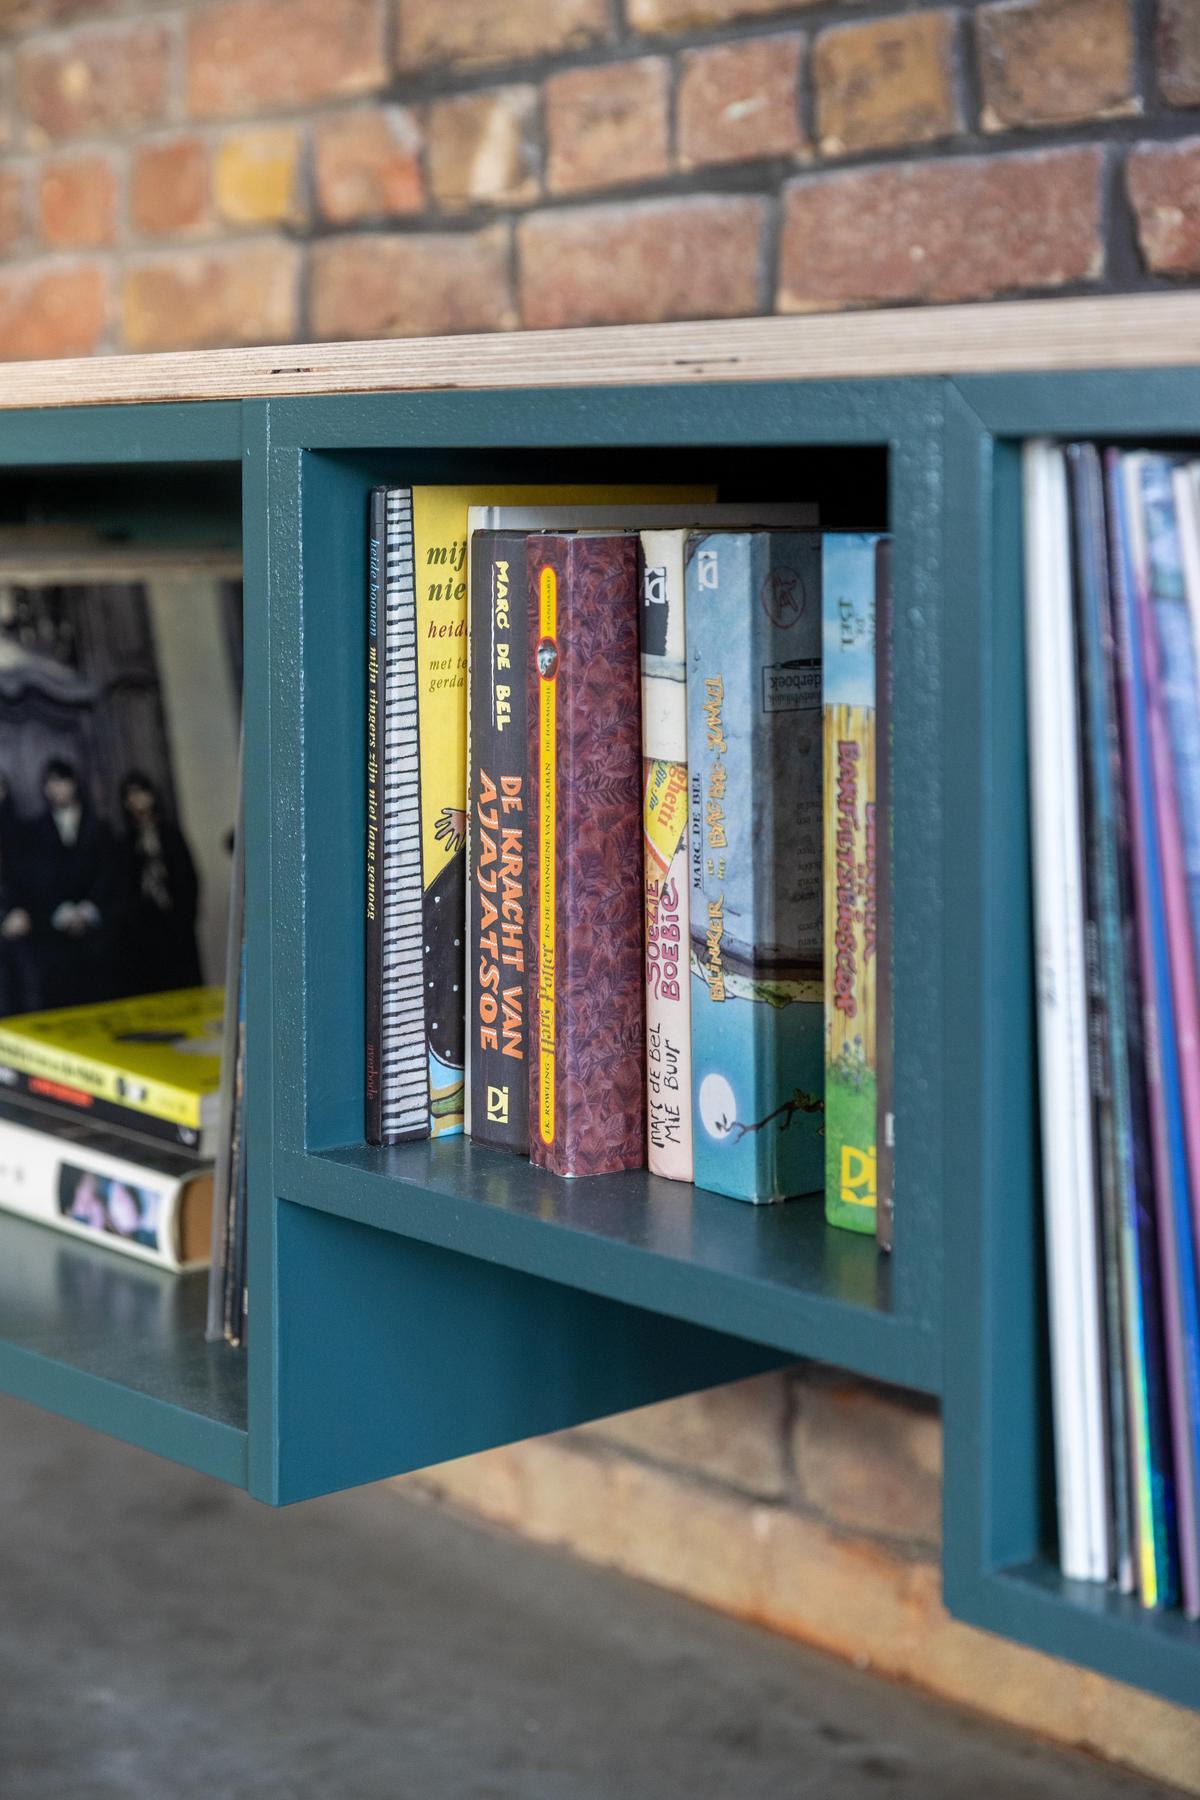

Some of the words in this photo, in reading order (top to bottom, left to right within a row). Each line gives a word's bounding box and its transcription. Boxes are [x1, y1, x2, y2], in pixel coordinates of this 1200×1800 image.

[369, 539, 381, 579] heide
[426, 540, 468, 572] mij
[428, 577, 467, 601] nie
[494, 560, 511, 630] MARC
[369, 583, 380, 637] boonen
[427, 620, 468, 638] heid
[368, 646, 379, 684] mijn
[429, 657, 451, 670] met
[456, 656, 468, 669] te
[496, 643, 511, 672] DE
[428, 676, 464, 693] gerda
[769, 673, 822, 691] derboek
[367, 689, 380, 748] vingers
[495, 684, 511, 732] BEL
[367, 751, 379, 784] zijn
[544, 762, 552, 813] AZKABAN
[368, 788, 379, 821] niet
[500, 775, 524, 815] DE
[656, 764, 689, 829] ghetti
[691, 771, 702, 806] BEL
[366, 824, 379, 861] lang
[544, 816, 552, 837] VAN
[692, 812, 702, 836] DE
[544, 839, 552, 904] GEVANGENE
[692, 841, 703, 890] MARC
[366, 862, 378, 921] genoeg
[476, 767, 500, 1051] AJAJATSOE
[498, 827, 525, 973] KRACHT
[544, 906, 552, 921] DE
[544, 924, 552, 939] EN
[536, 943, 555, 1003] Potter
[501, 985, 524, 1060] VAN
[539, 1008, 556, 1056] Harry
[544, 1062, 552, 1117] ROWLING
